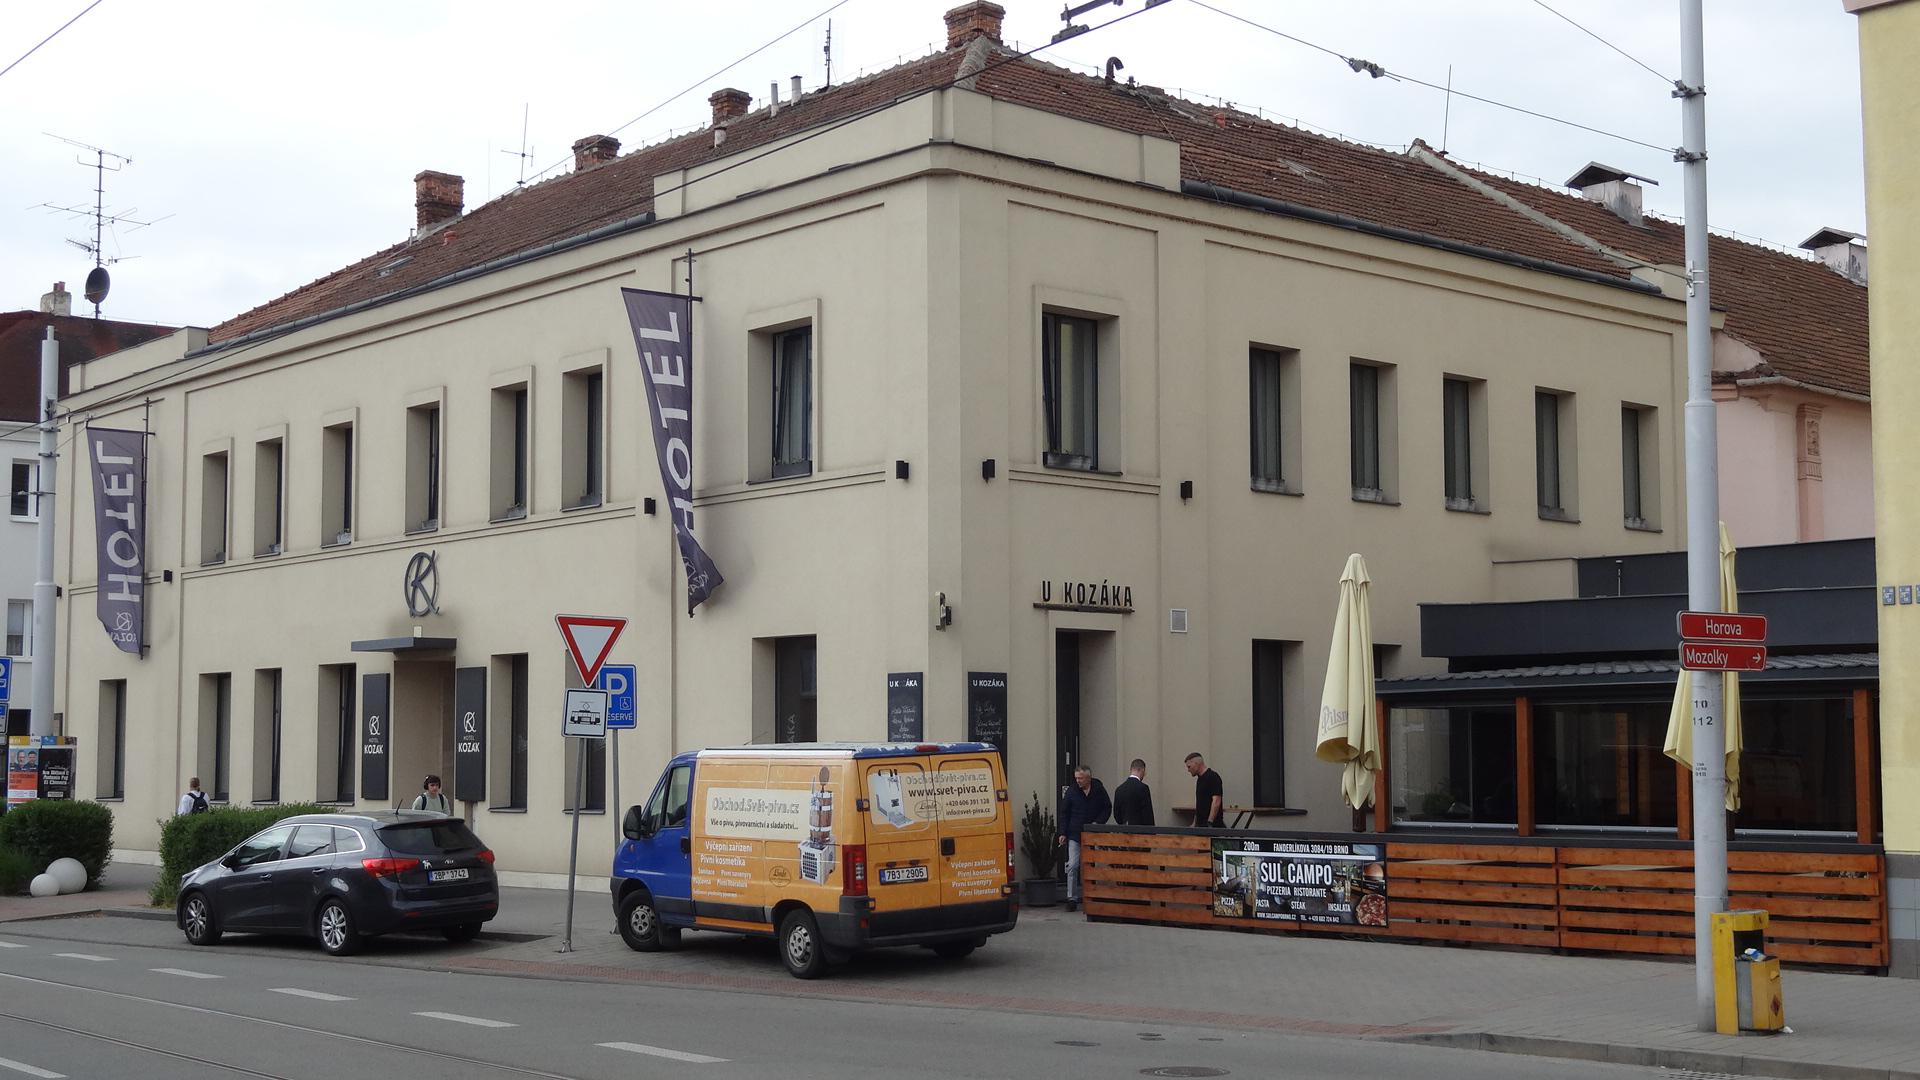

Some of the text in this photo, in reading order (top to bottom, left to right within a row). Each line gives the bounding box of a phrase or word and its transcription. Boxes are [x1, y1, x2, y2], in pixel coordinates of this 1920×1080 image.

[640, 311, 695, 539] HOTEL
[1042, 579, 1133, 607] U KOZÁKA
[1705, 619, 1742, 636] Horova
[1686, 648, 1728, 668] Mozolky
[972, 678, 1005, 688] U KOZÁKA
[1694, 700, 1708, 709] 10
[607, 712, 633, 721] ESERVE
[908, 784, 989, 798] www.svet-piva.cz
[1243, 841, 1260, 851] 200m
[1273, 843, 1310, 853] FANDERLÍKOVA
[1333, 845, 1349, 854] BRNO
[886, 868, 924, 880] 7B3 2905
[1260, 862, 1332, 885] SUL CAMPO
[1266, 886, 1327, 898] PIZZERIA RISTORANTE
[1221, 897, 1235, 906] PIZZA
[1255, 899, 1270, 908] PASTA
[1291, 901, 1306, 910] STEAK
[1327, 903, 1351, 912] INSALATA
